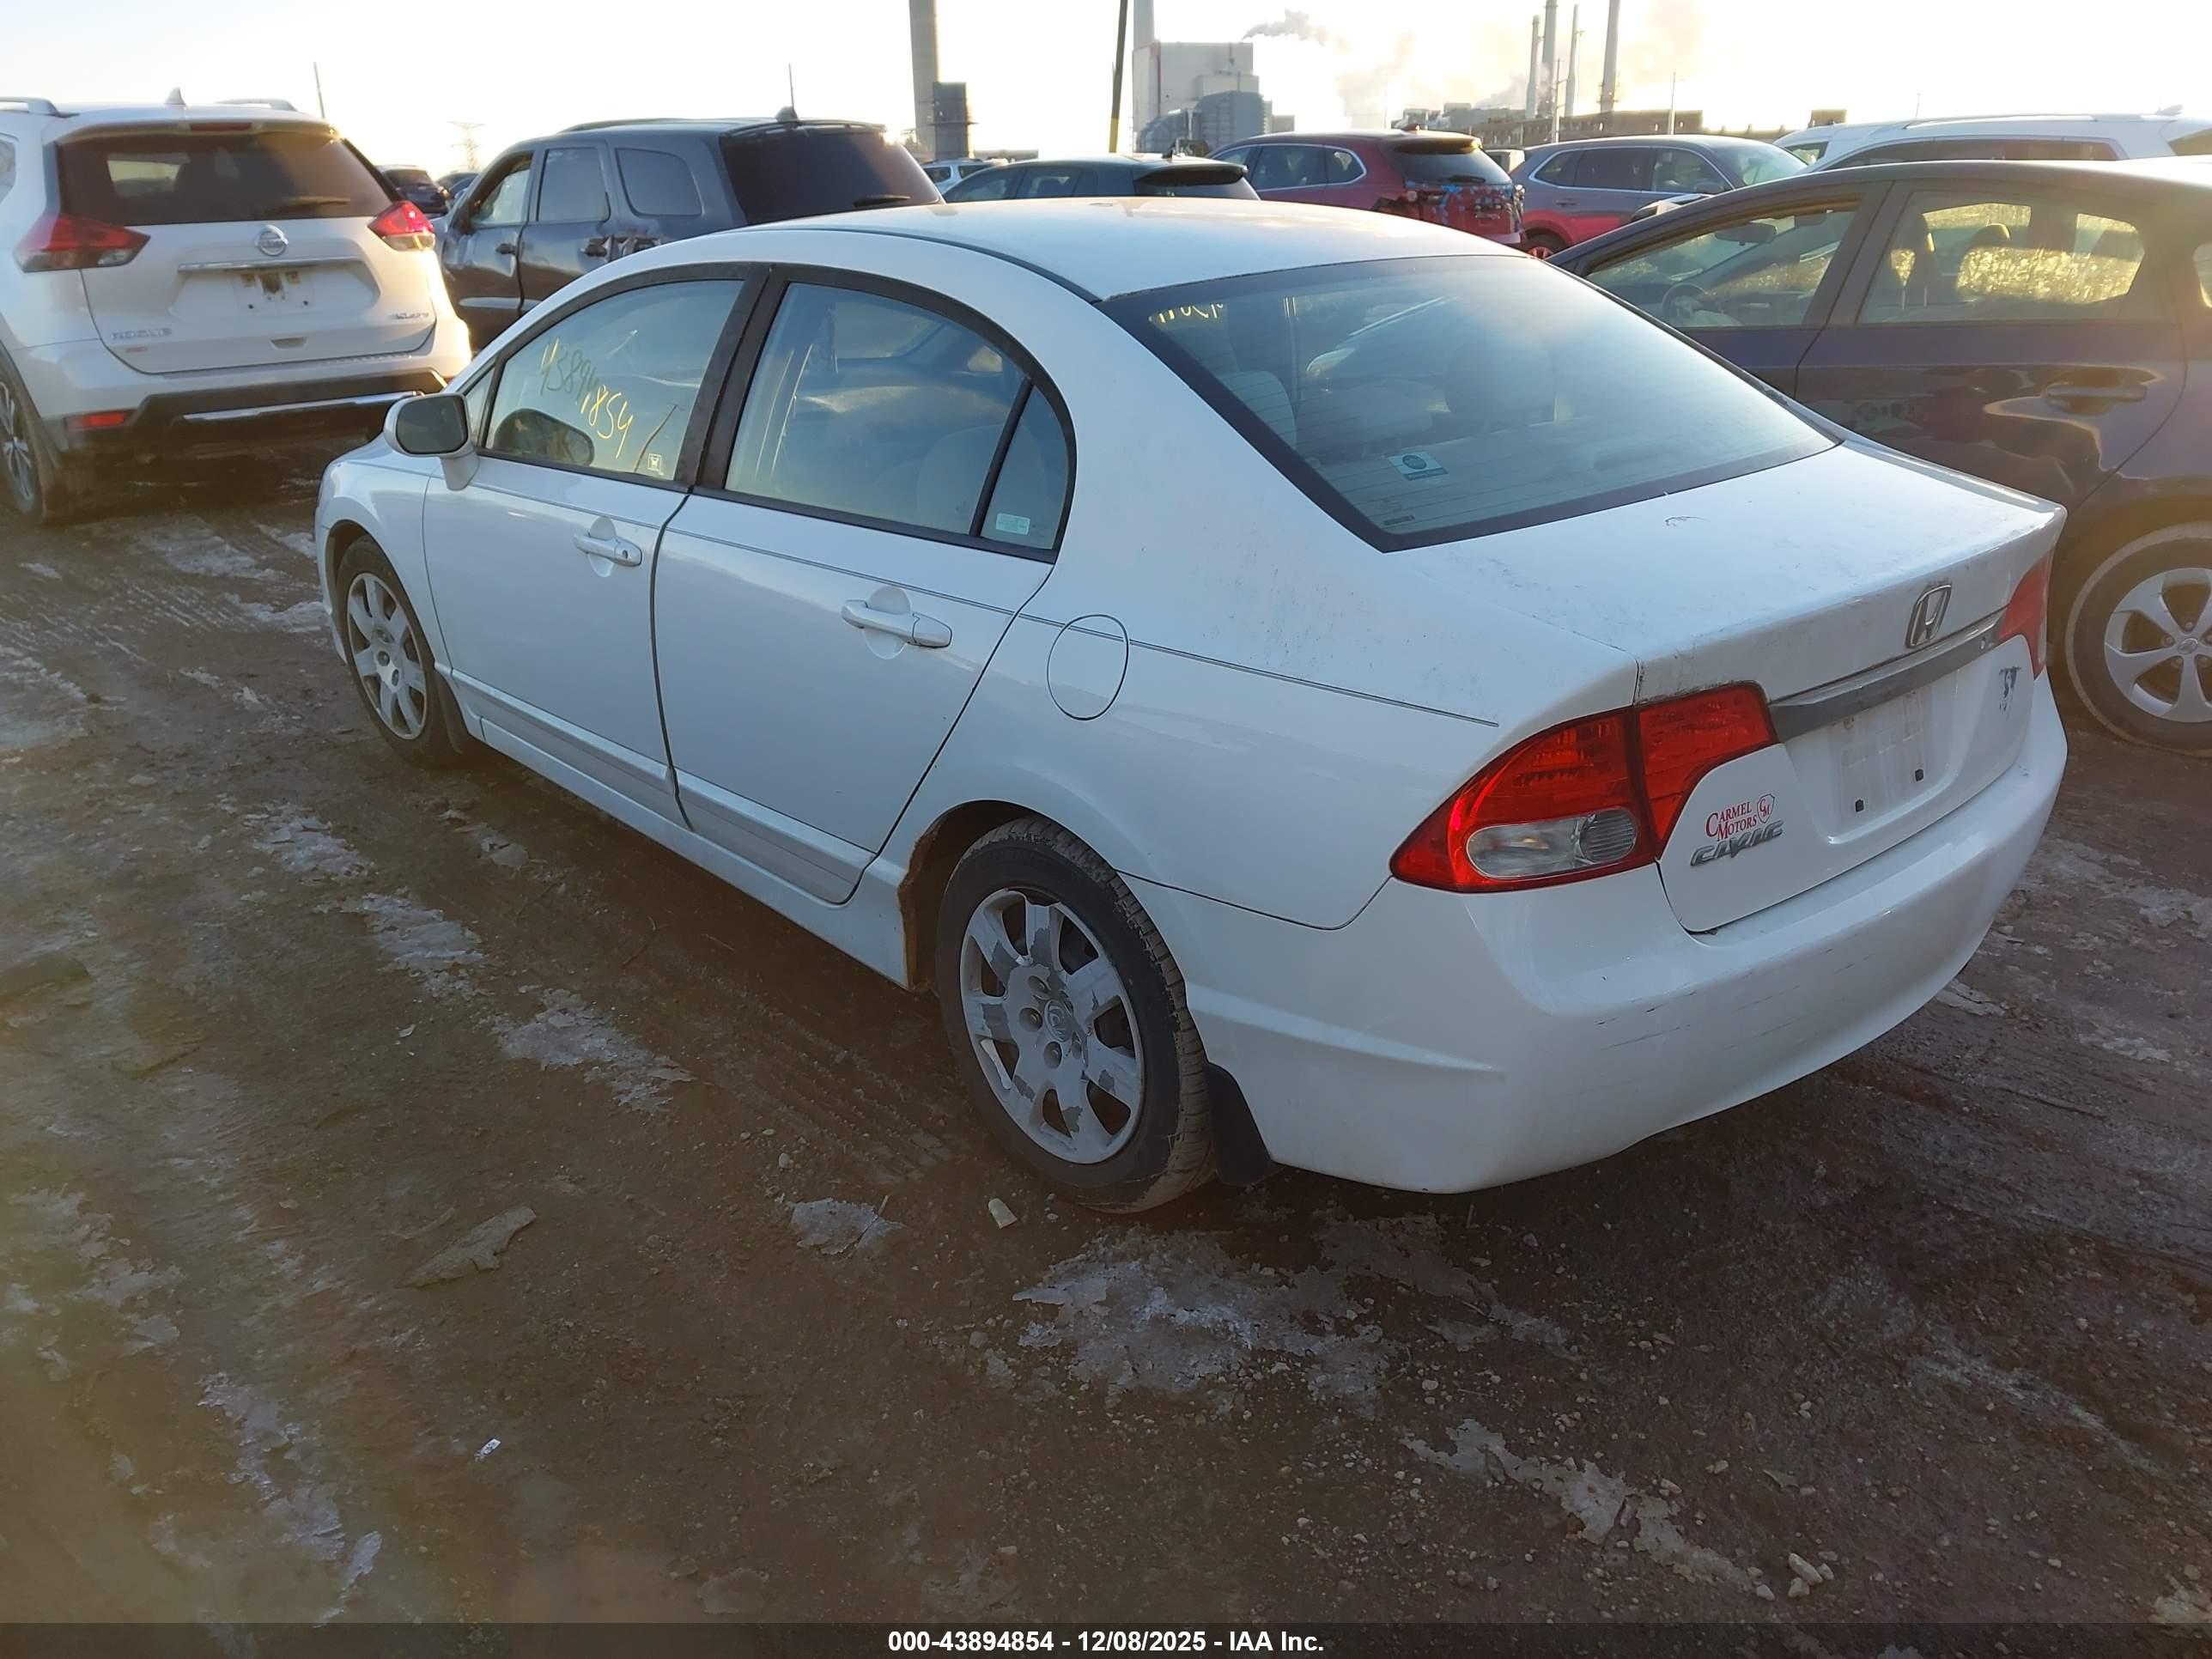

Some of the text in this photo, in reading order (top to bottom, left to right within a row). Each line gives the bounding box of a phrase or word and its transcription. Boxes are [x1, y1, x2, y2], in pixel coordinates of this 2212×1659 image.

[1705, 801, 1753, 837] CARMEL
[1717, 814, 1758, 842] MOTORS
[1690, 819, 1784, 866] CIVIC
